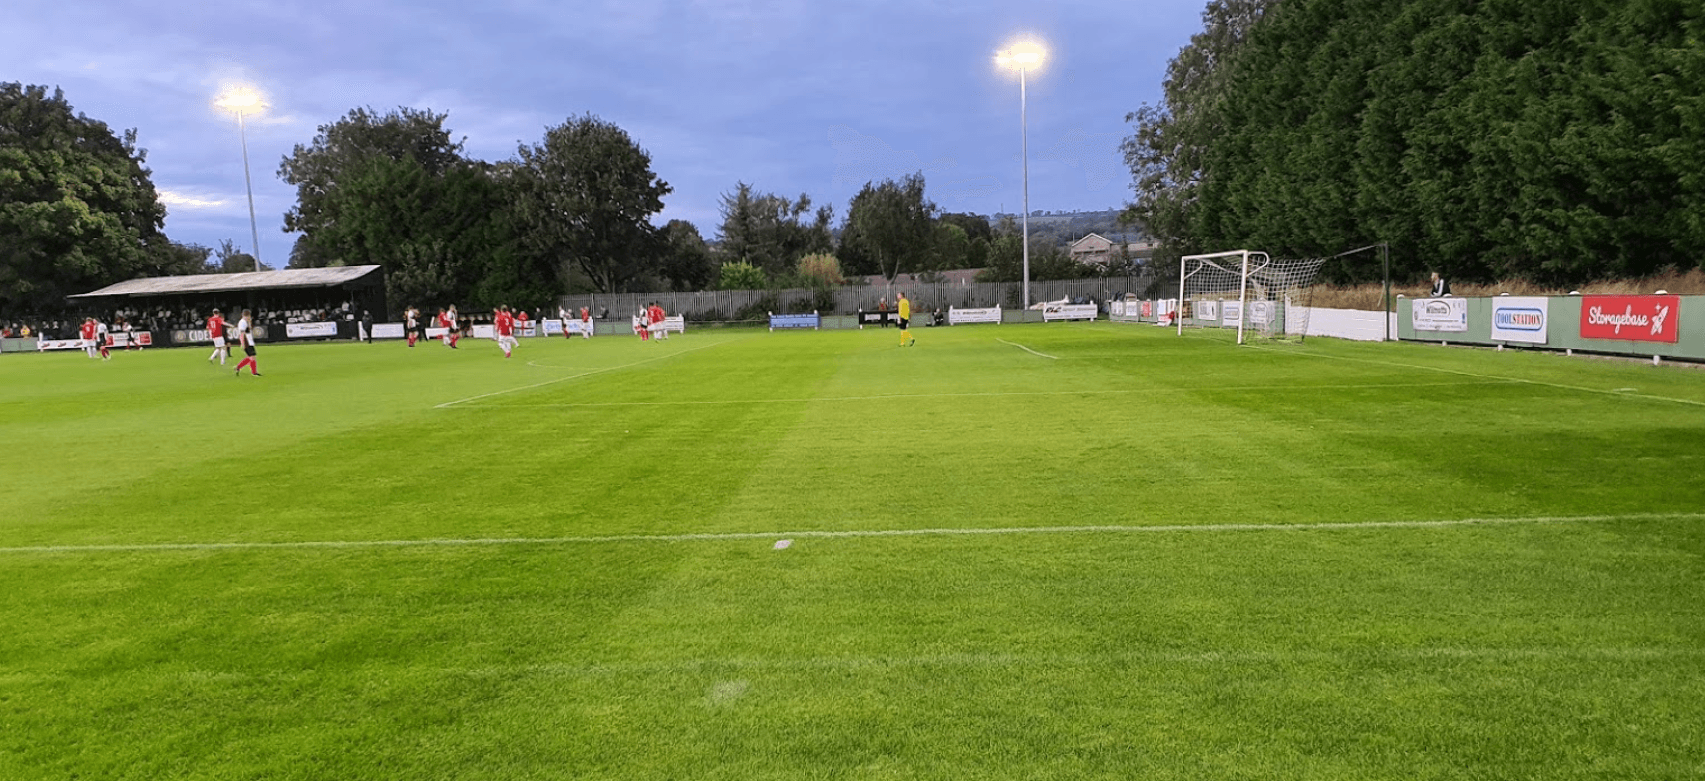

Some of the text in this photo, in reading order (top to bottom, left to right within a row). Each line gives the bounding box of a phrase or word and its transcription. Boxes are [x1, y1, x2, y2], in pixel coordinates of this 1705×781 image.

[1497, 313, 1542, 325] TOOLSTATION
[1588, 304, 1649, 335] Storagebase
[189, 330, 213, 341] CIDE
